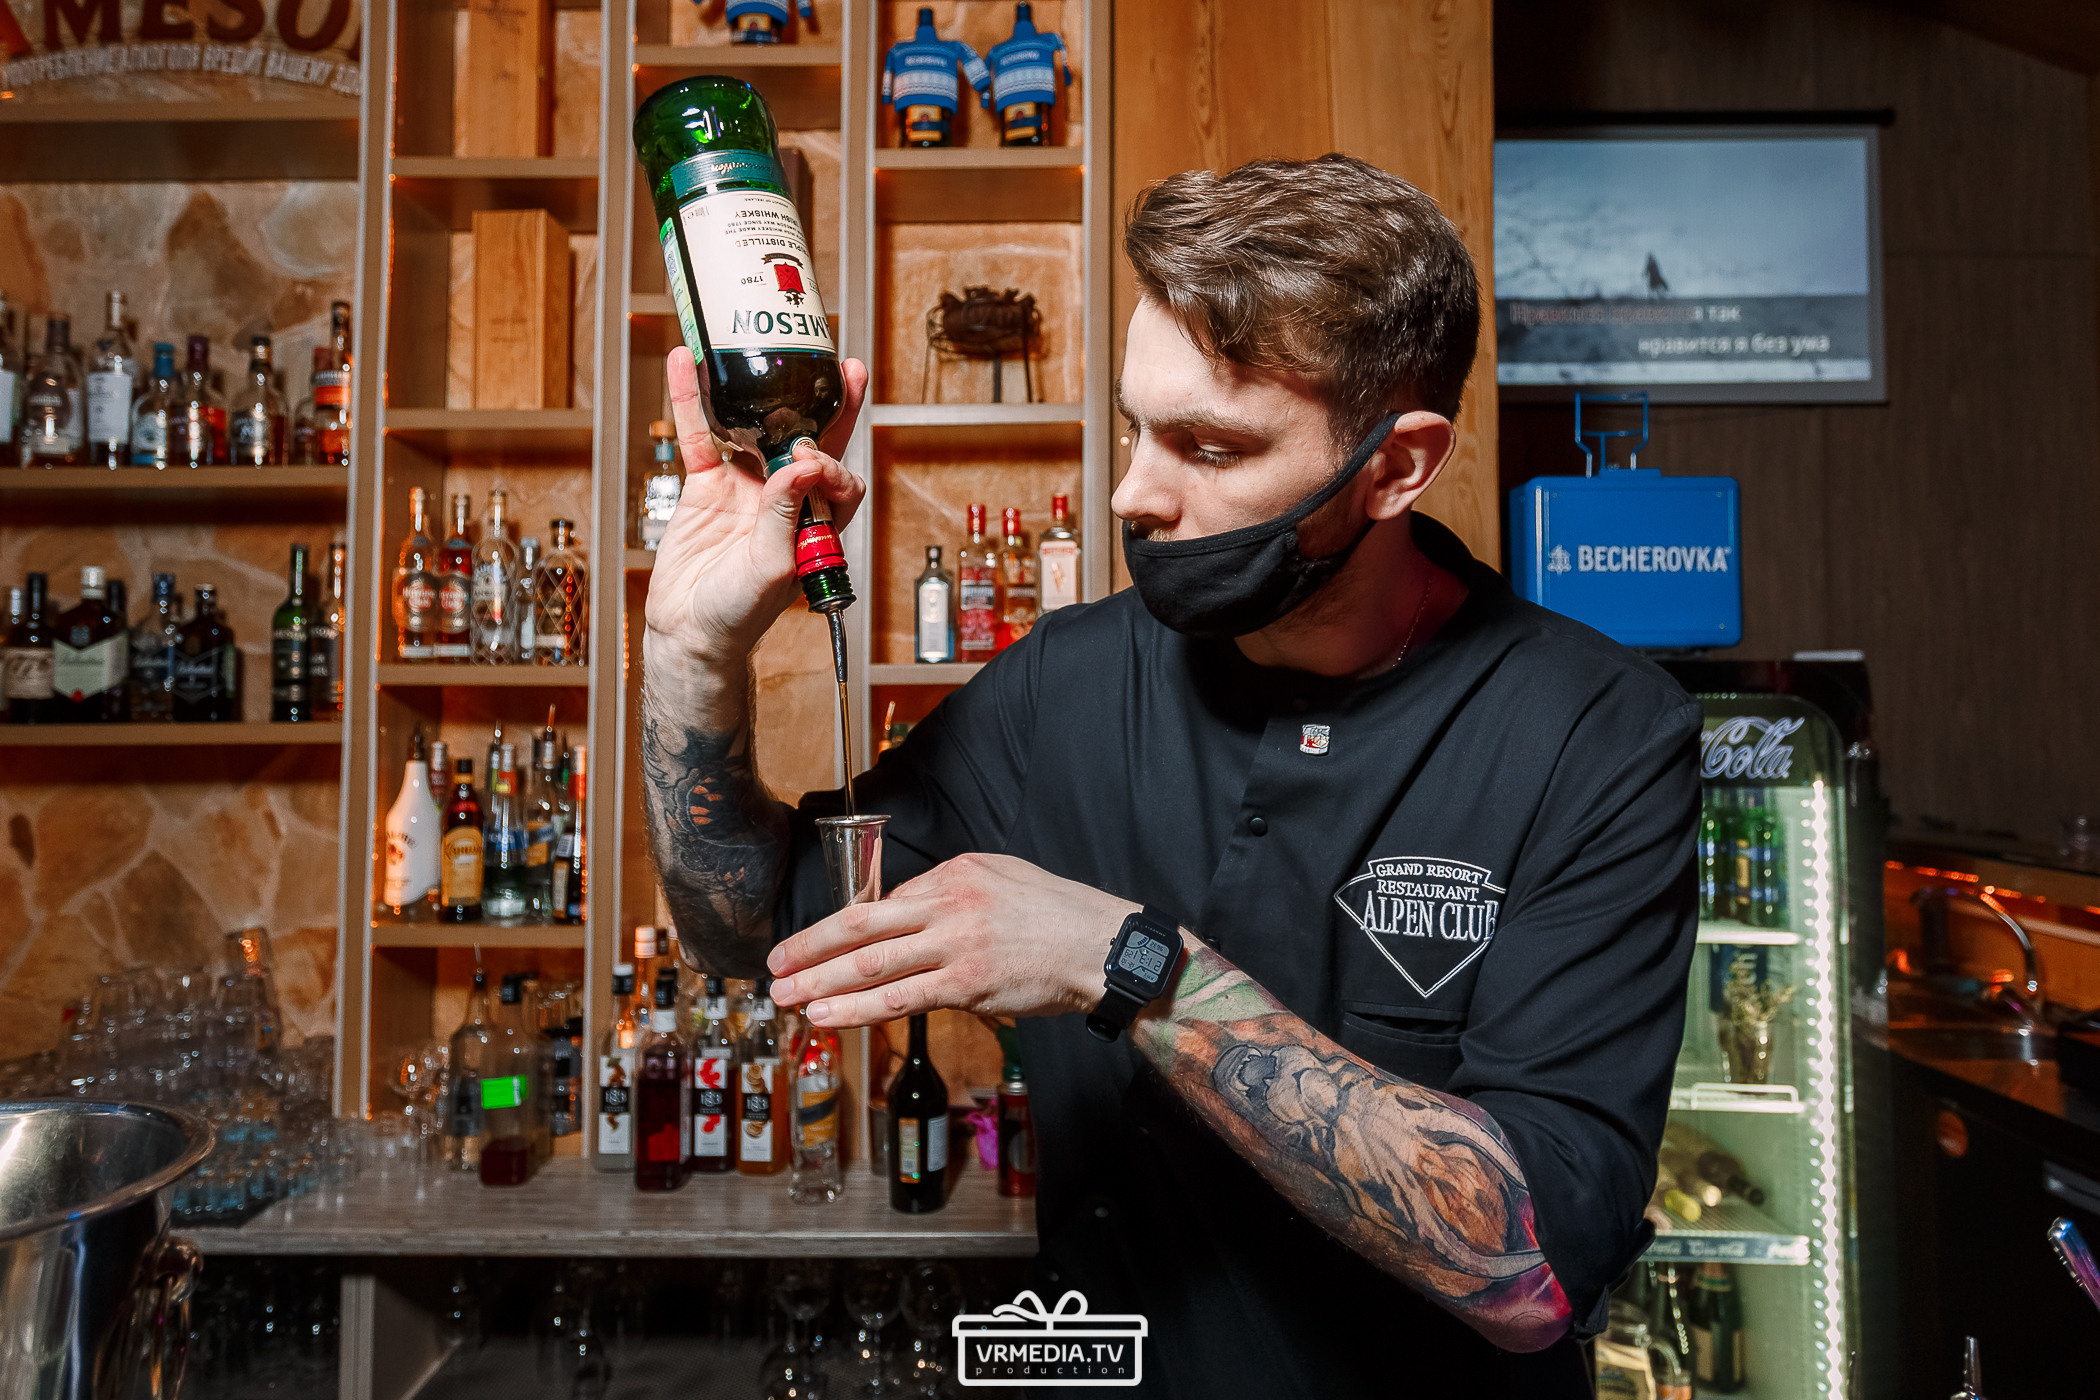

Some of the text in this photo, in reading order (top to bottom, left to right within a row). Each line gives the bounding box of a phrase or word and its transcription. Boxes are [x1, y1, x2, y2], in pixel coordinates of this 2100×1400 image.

[734, 209, 780, 220] WHISKEY
[757, 226, 783, 234] WHISKEY
[735, 238, 786, 248] DISTILLED
[740, 275, 764, 285] 1780
[1578, 545, 1729, 572] BECHEROVKA
[1376, 863, 1483, 885] GRAND RESORT
[1376, 879, 1480, 902] RESTAURANT
[1360, 890, 1499, 943] ALPEN CLUB
